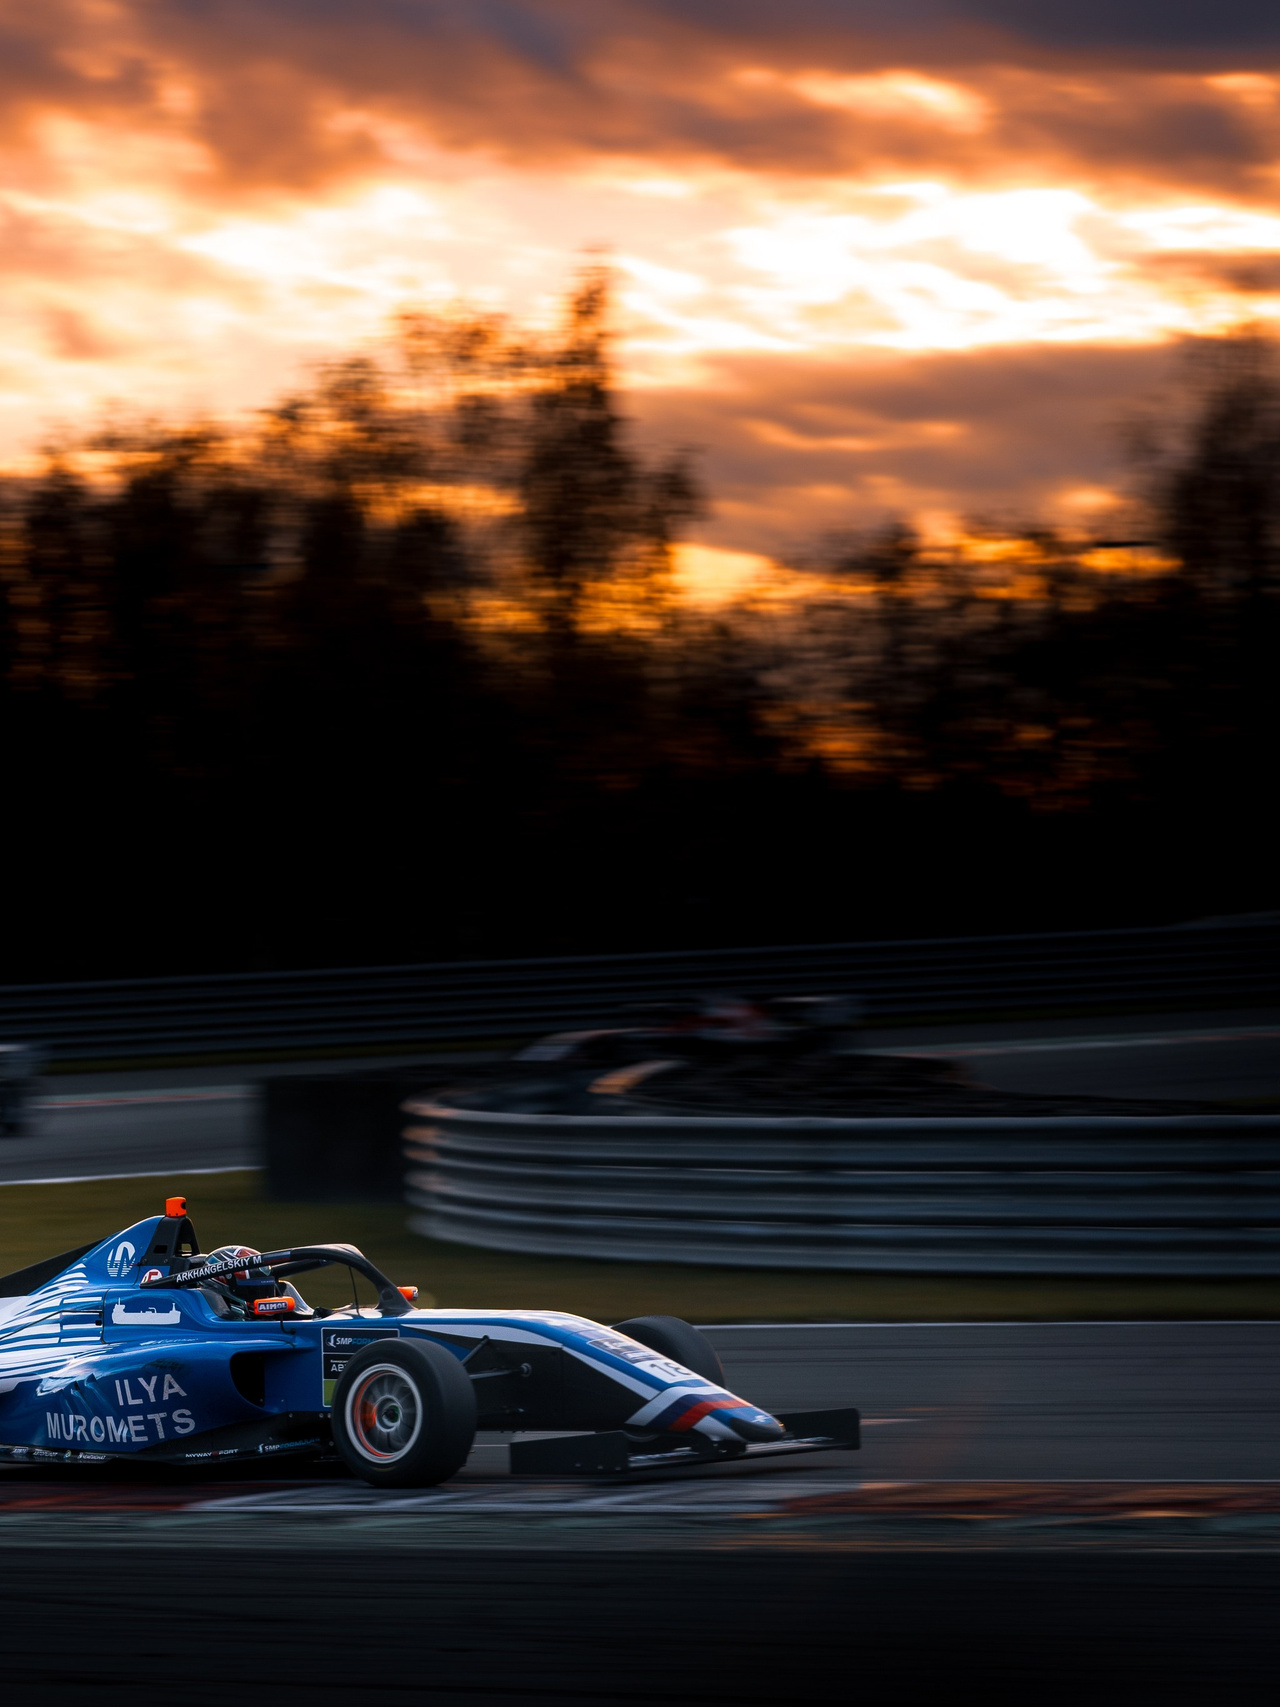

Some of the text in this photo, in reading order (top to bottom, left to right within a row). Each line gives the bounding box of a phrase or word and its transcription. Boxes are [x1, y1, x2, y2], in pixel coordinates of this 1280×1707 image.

[176, 1257, 250, 1283] ARKHANGELSKIY
[253, 1255, 262, 1265] M
[259, 1302, 287, 1311] AIMOL
[114, 1373, 188, 1406] ILYA
[46, 1408, 196, 1443] MUROMETS
